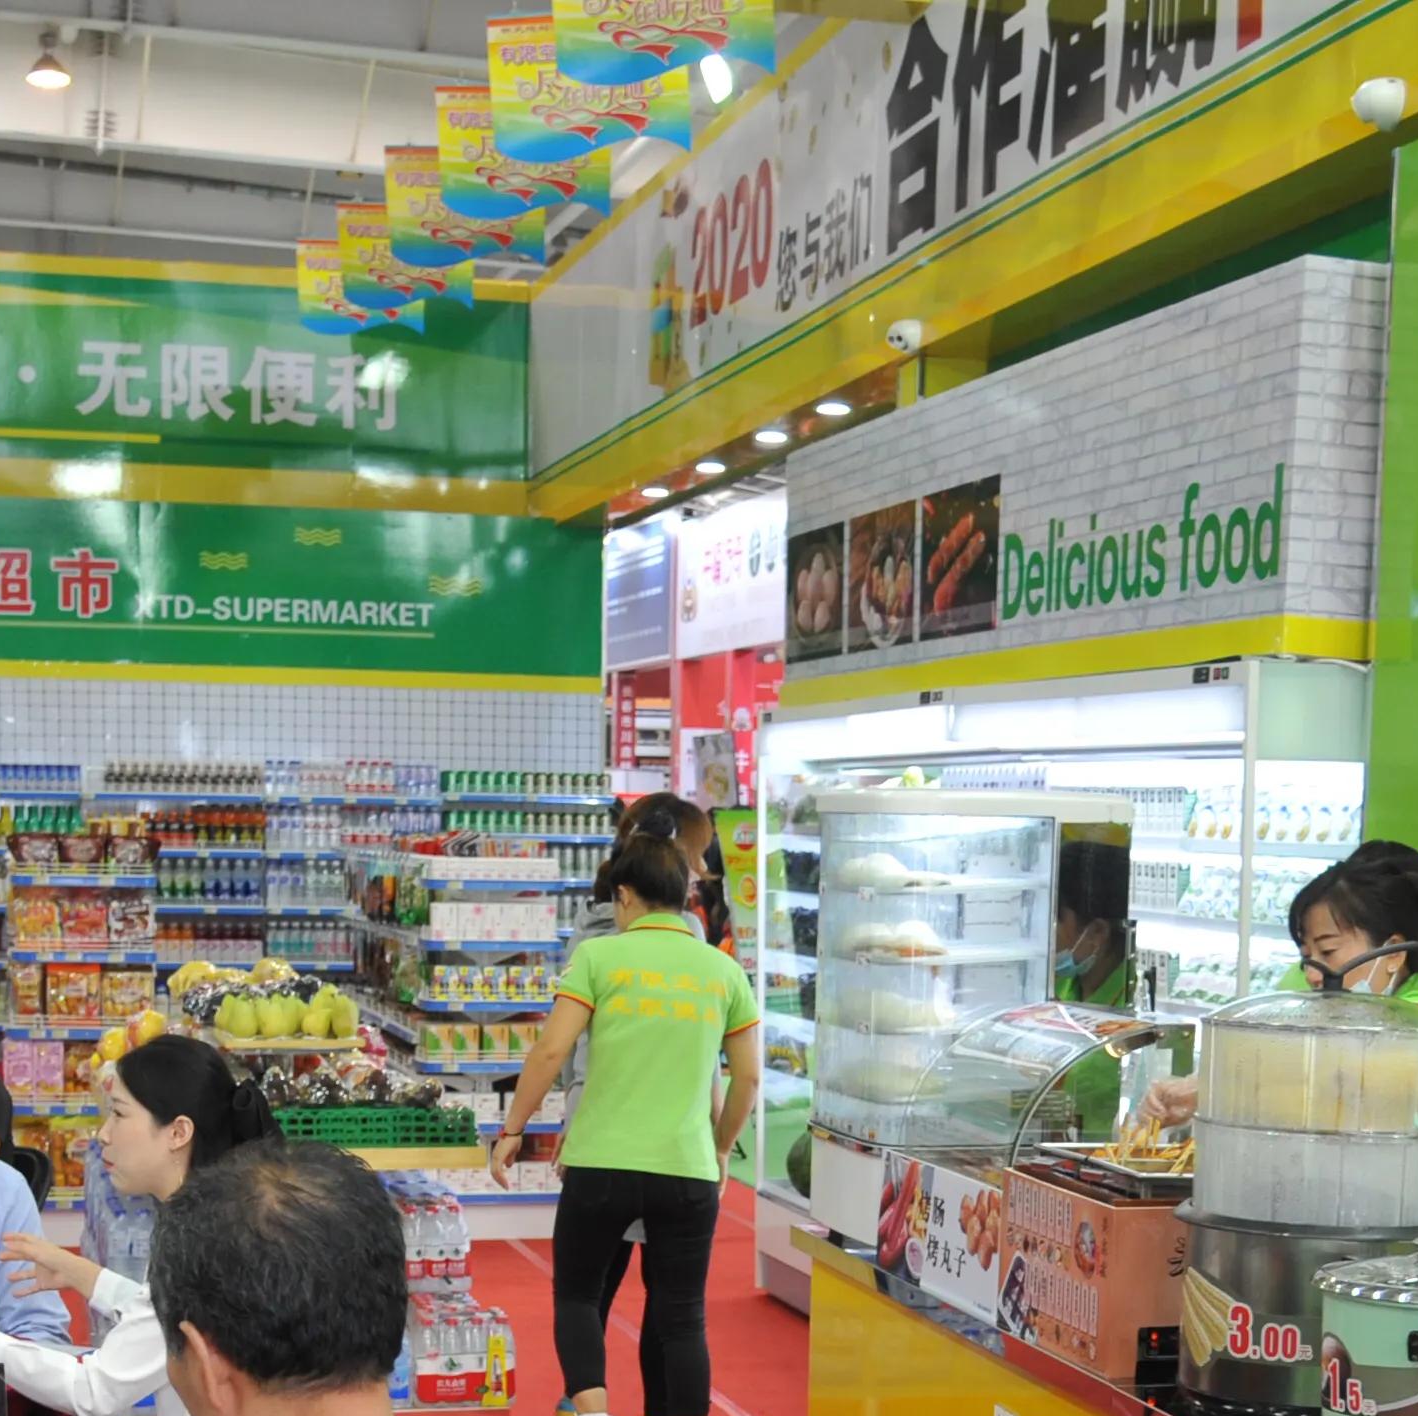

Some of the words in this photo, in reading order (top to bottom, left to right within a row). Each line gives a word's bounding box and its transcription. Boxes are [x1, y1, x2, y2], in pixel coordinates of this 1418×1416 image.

[690, 158, 773, 328] 2020
[775, 171, 873, 312] 您与我们
[133, 594, 435, 628] XTD-SUPERMARKET
[1001, 513, 1168, 622] Delicious
[1179, 463, 1285, 591] food
[926, 1234, 967, 1278] 烤丸子
